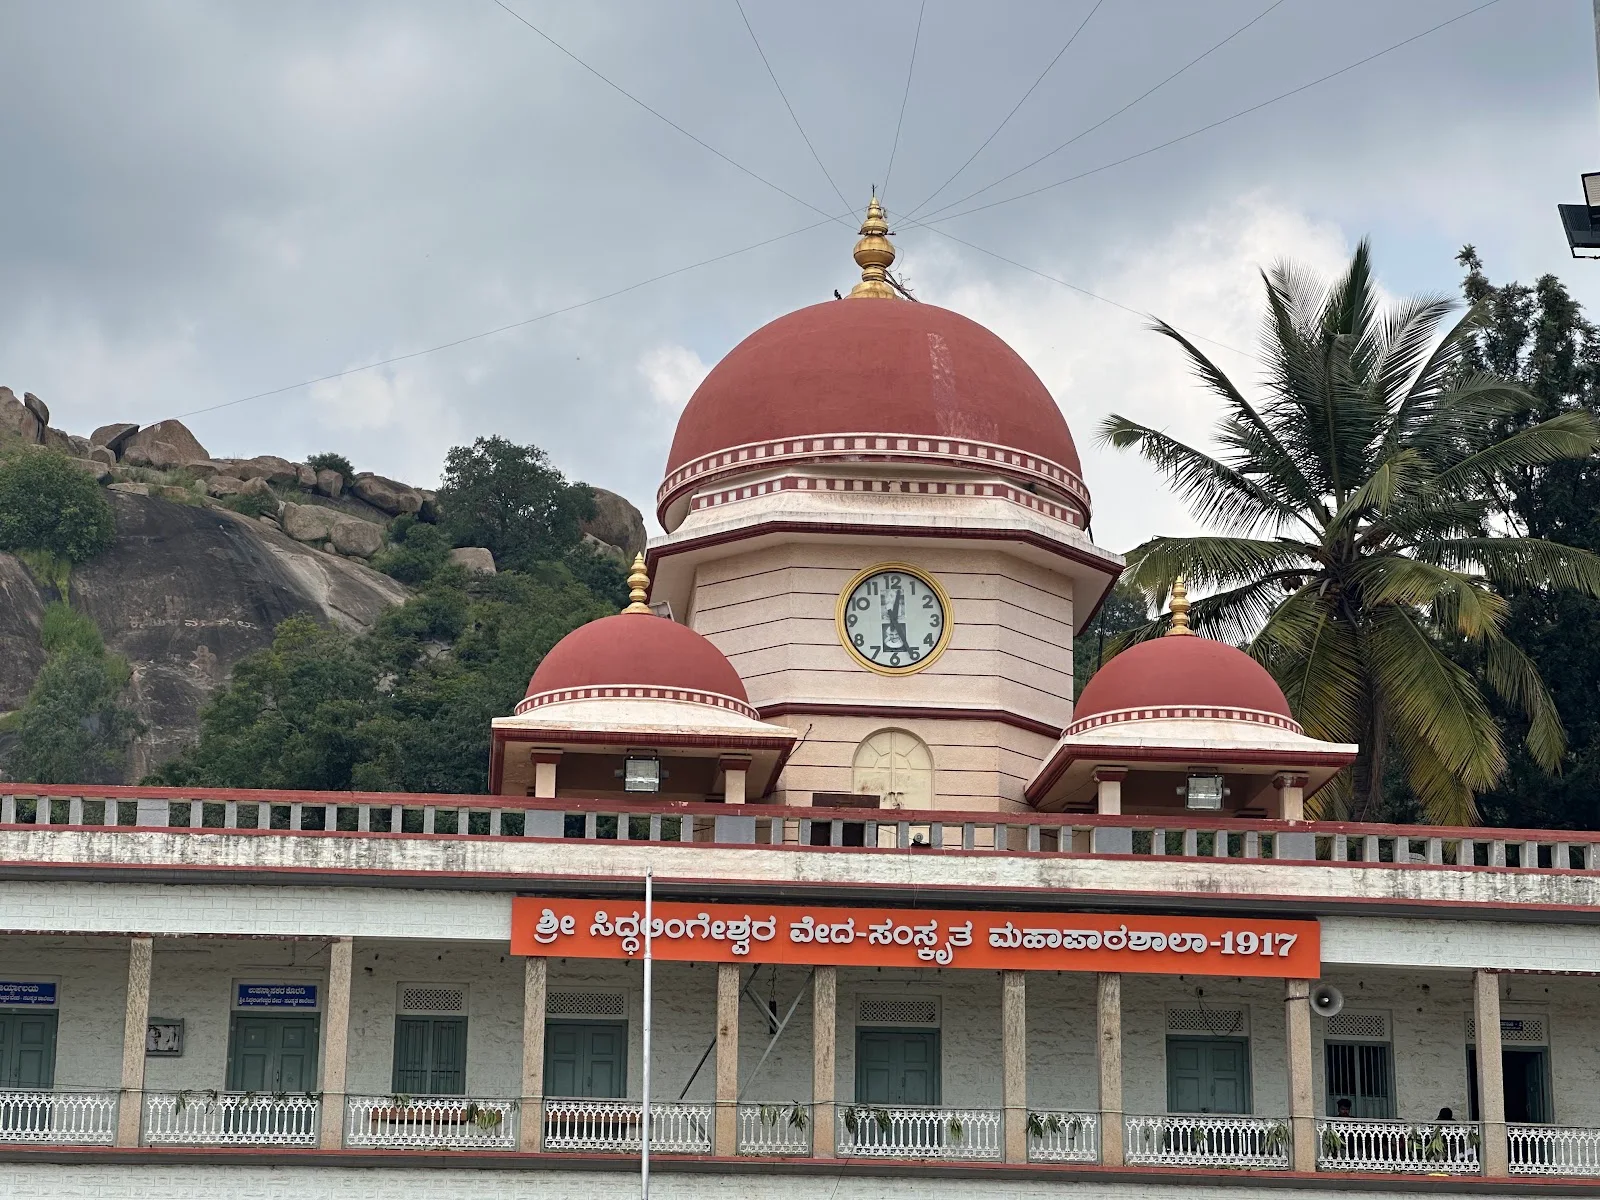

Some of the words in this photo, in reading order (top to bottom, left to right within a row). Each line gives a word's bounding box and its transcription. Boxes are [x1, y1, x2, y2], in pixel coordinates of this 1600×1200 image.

[865, 582, 878, 596] 11
[883, 575, 902, 590] 12
[909, 581, 916, 595] 1
[850, 597, 870, 611] 10
[922, 595, 934, 609] 2
[847, 614, 858, 628] 9
[930, 614, 940, 628] 3
[854, 633, 865, 647] 8
[923, 633, 934, 647] 4
[870, 646, 881, 660] 7
[889, 653, 900, 667] 6
[910, 647, 920, 661] 5
[534, 909, 575, 943] ಶ್ರೀ
